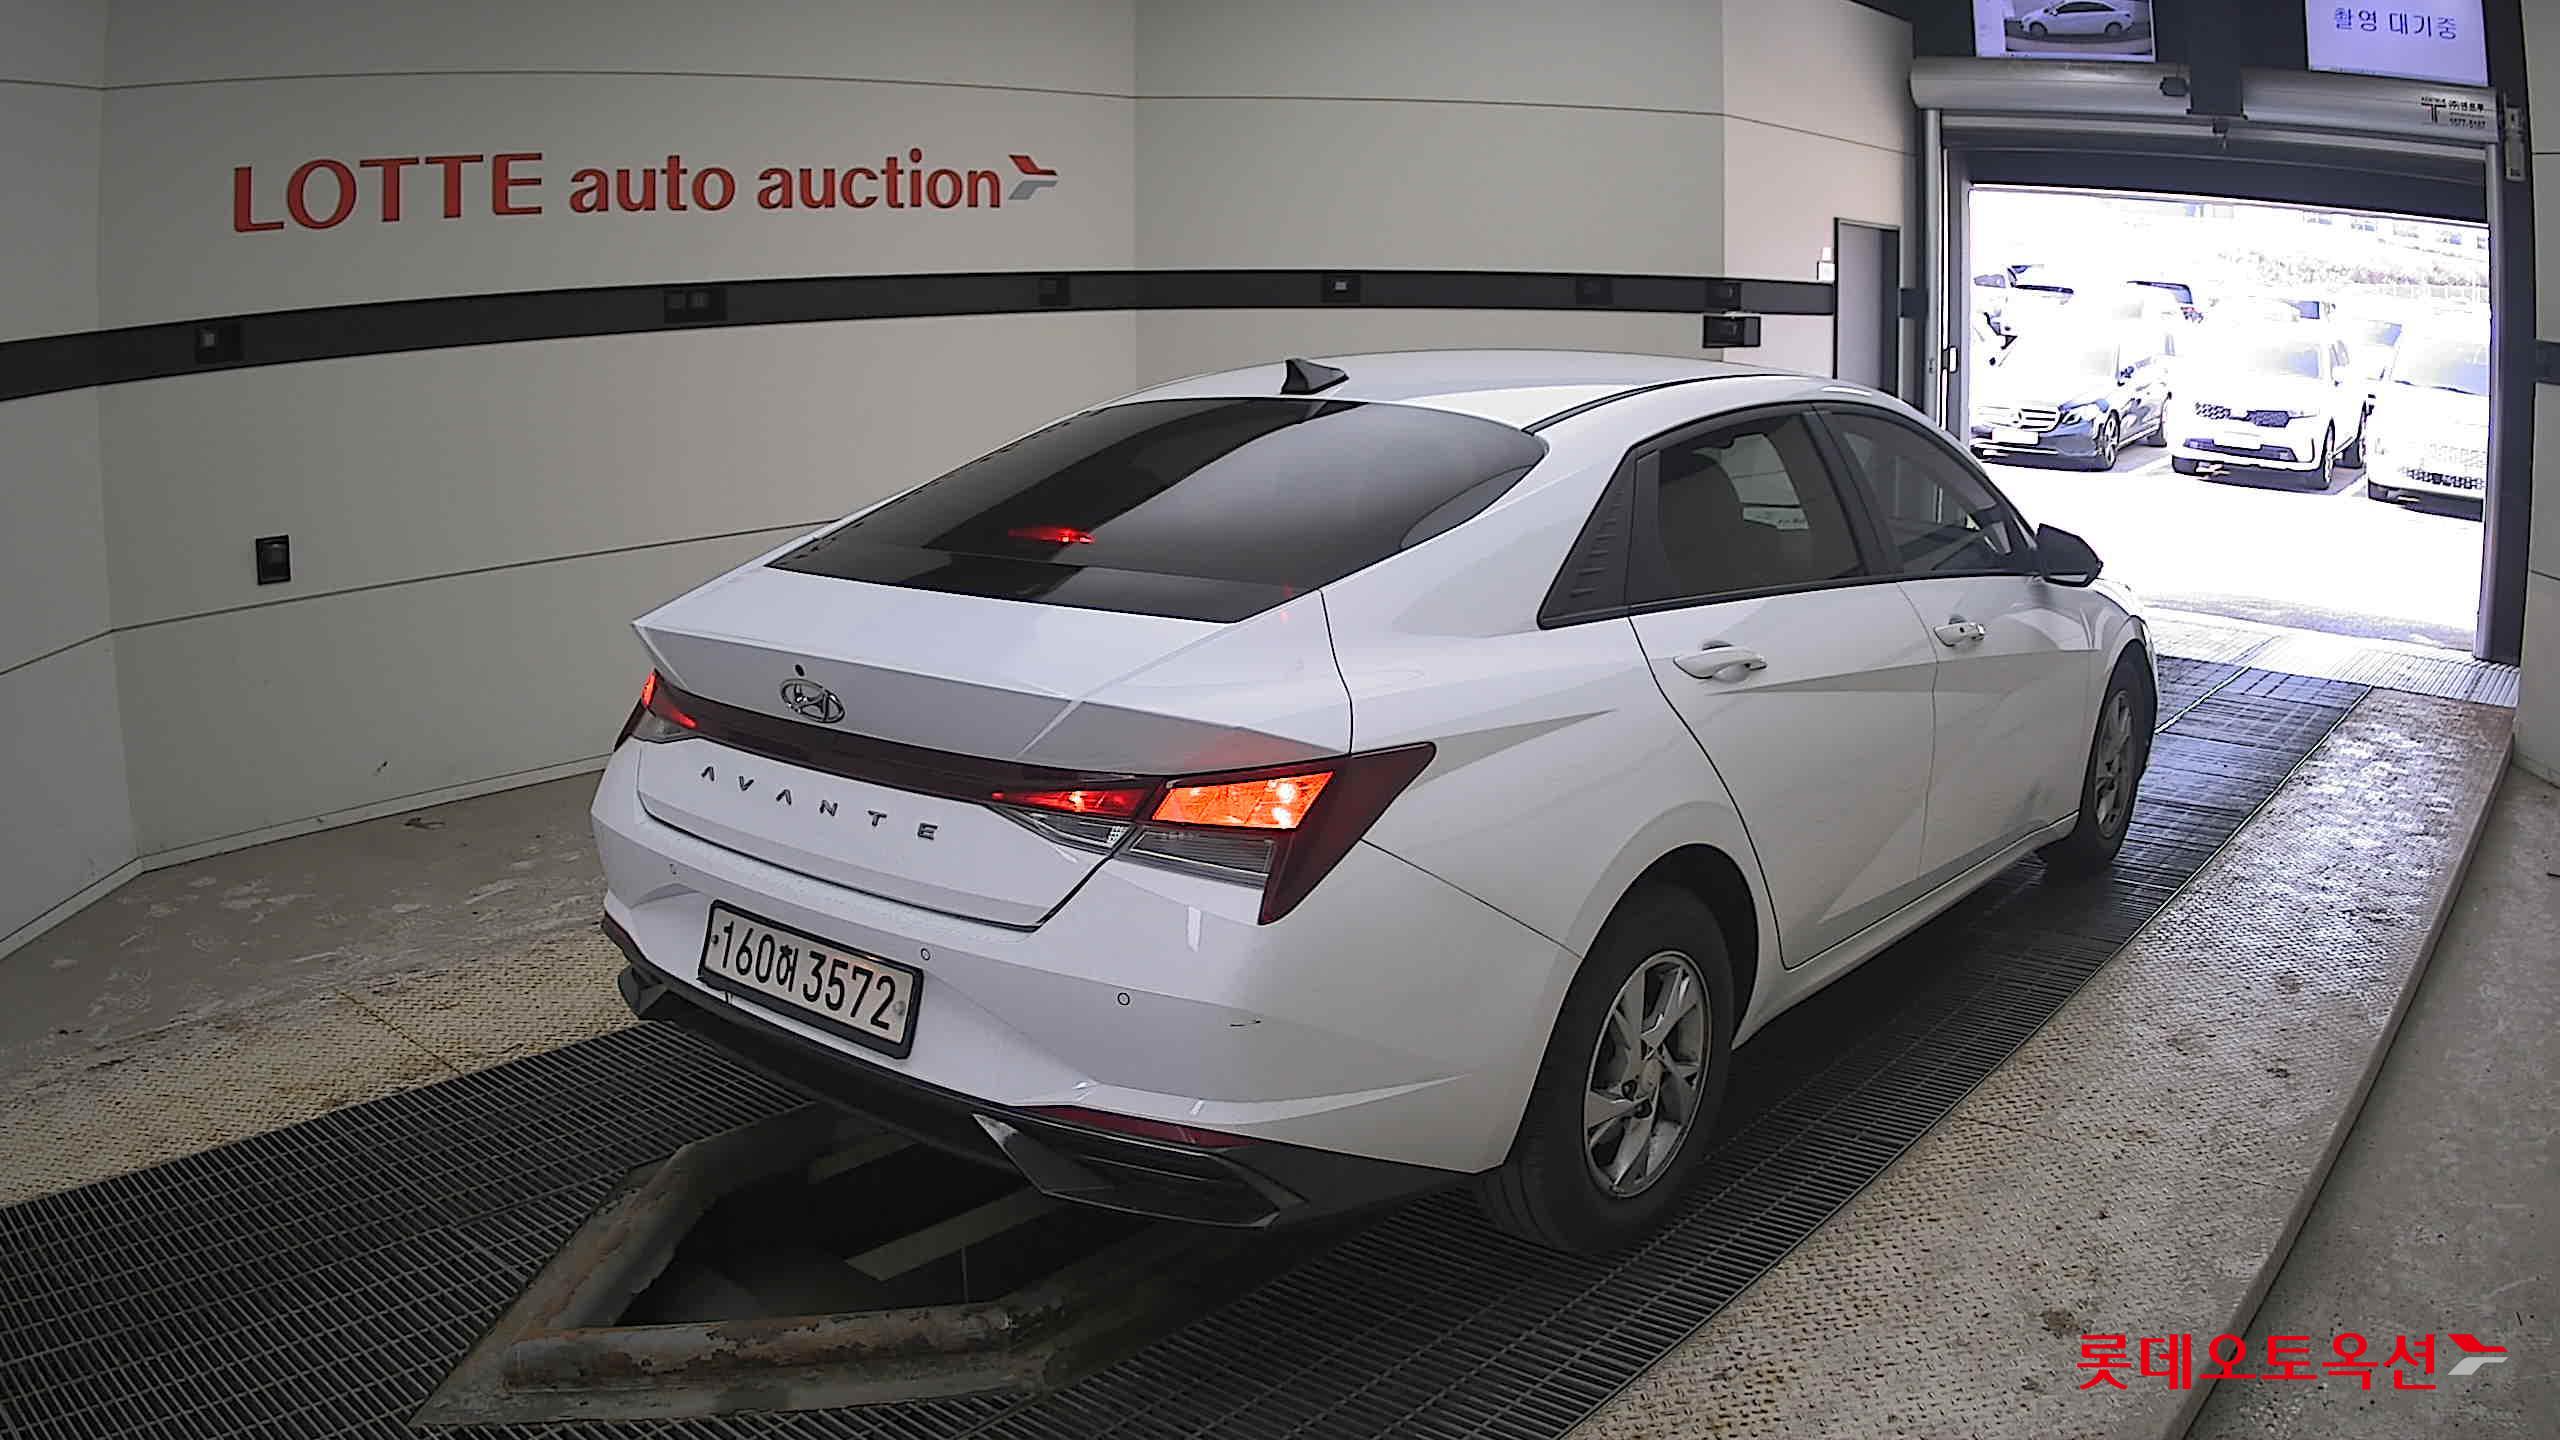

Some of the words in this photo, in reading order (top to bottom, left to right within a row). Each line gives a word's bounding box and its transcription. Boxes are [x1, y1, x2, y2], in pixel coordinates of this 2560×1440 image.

[236, 156, 542, 231] LOTTE
[570, 157, 735, 213] auto
[759, 147, 1000, 209] auction
[700, 766, 938, 841] AVANTE
